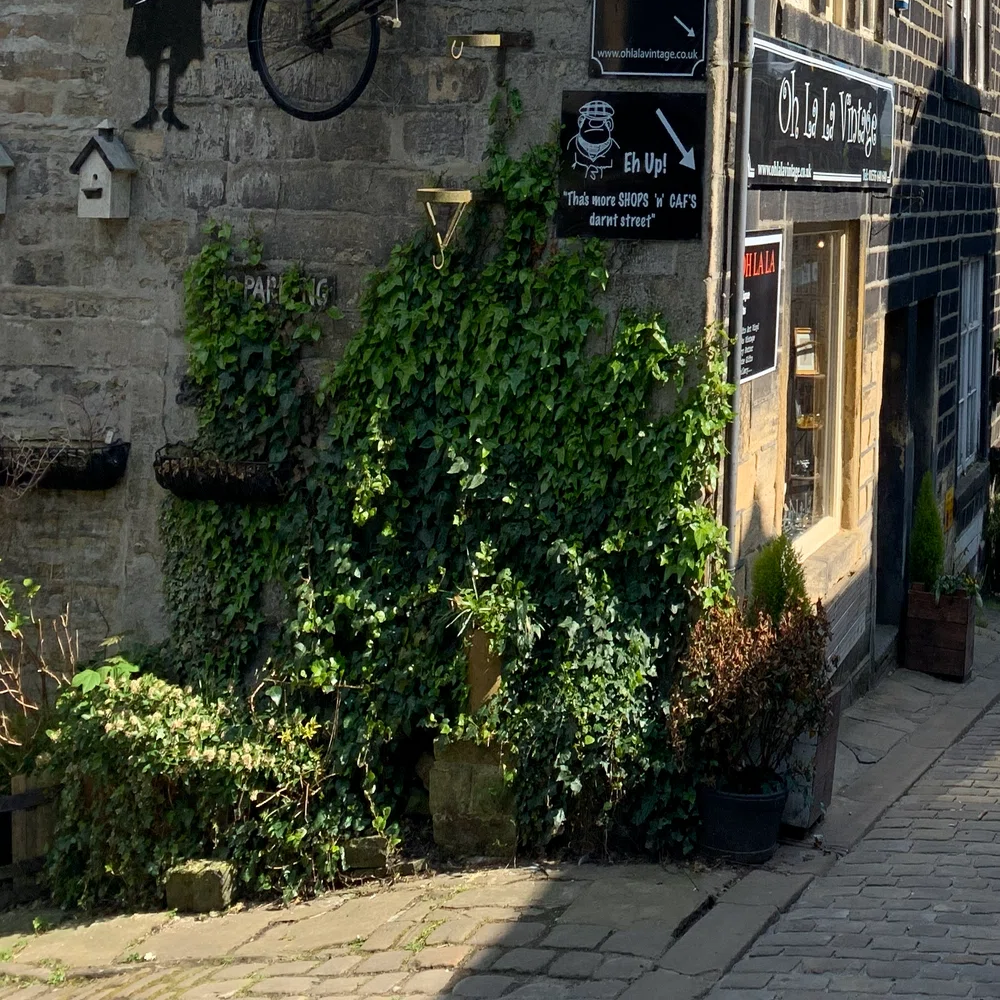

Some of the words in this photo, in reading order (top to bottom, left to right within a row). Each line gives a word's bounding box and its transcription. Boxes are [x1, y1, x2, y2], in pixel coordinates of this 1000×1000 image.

[597, 47, 698, 61] www.ohlalavintage.co.uk
[778, 69, 799, 140] Oh
[803, 82, 818, 139] La
[821, 87, 836, 141] La
[839, 90, 877, 158] Vintage
[624, 151, 640, 174] Eh
[644, 152, 667, 178] Up!
[591, 194, 616, 207] more
[618, 192, 649, 207] SHOPS
[654, 192, 665, 208] 'n'
[589, 212, 619, 227] darnt
[620, 213, 656, 228] street"
[753, 252, 764, 276] LA
[765, 249, 775, 274] LA
